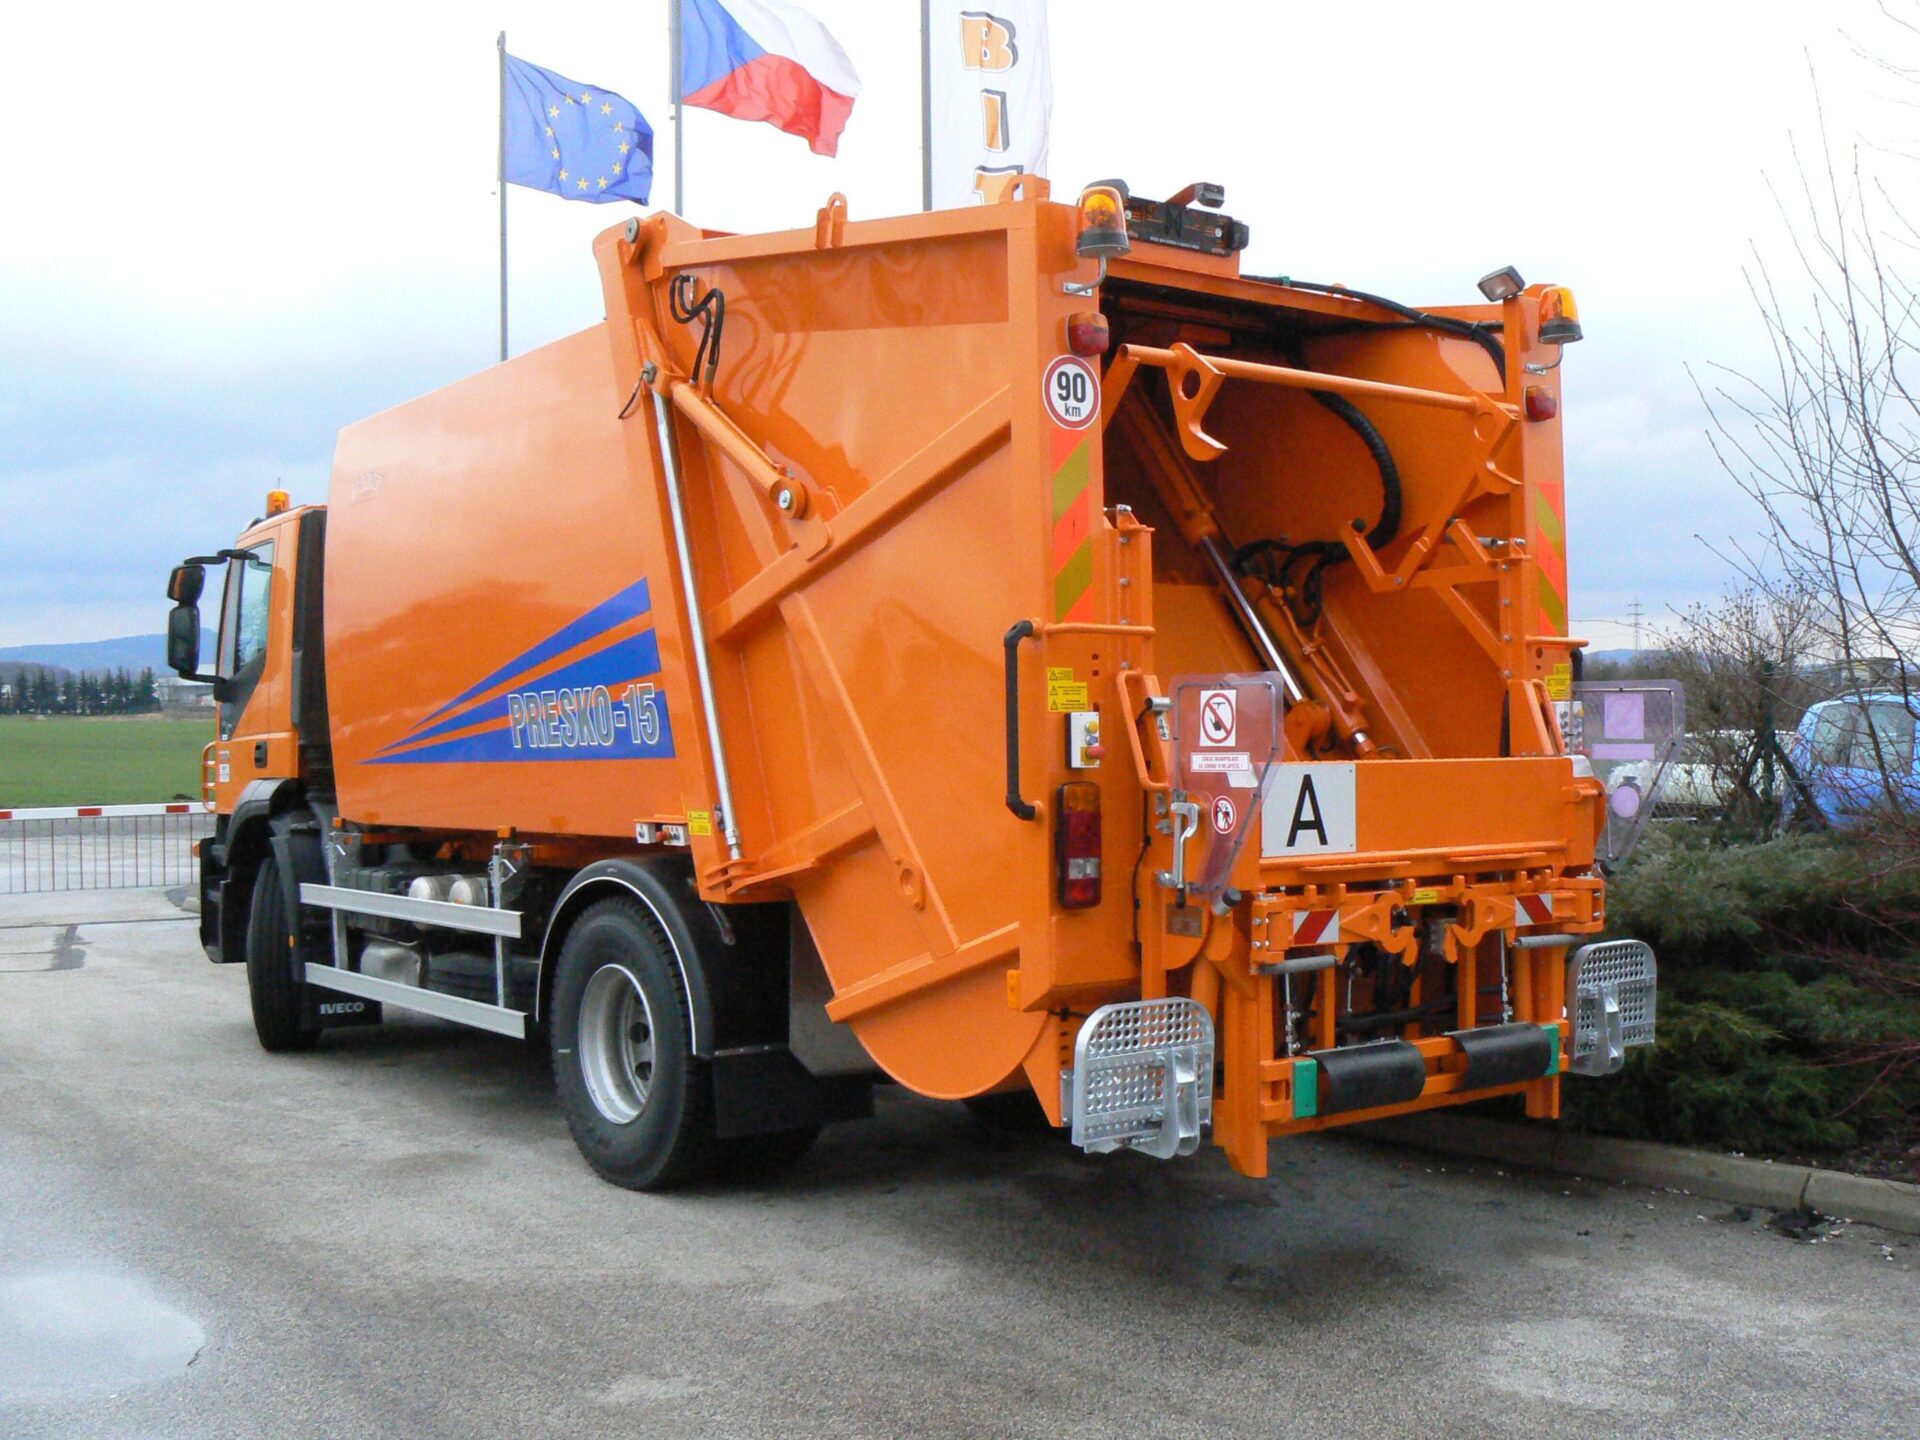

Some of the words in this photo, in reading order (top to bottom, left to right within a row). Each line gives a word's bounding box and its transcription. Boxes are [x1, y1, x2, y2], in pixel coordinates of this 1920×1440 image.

[1056, 371, 1086, 403] 90
[1064, 403, 1081, 418] km
[508, 683, 660, 748] PRESKO-15
[1286, 773, 1328, 847] A
[320, 1002, 365, 1015] IVECO
